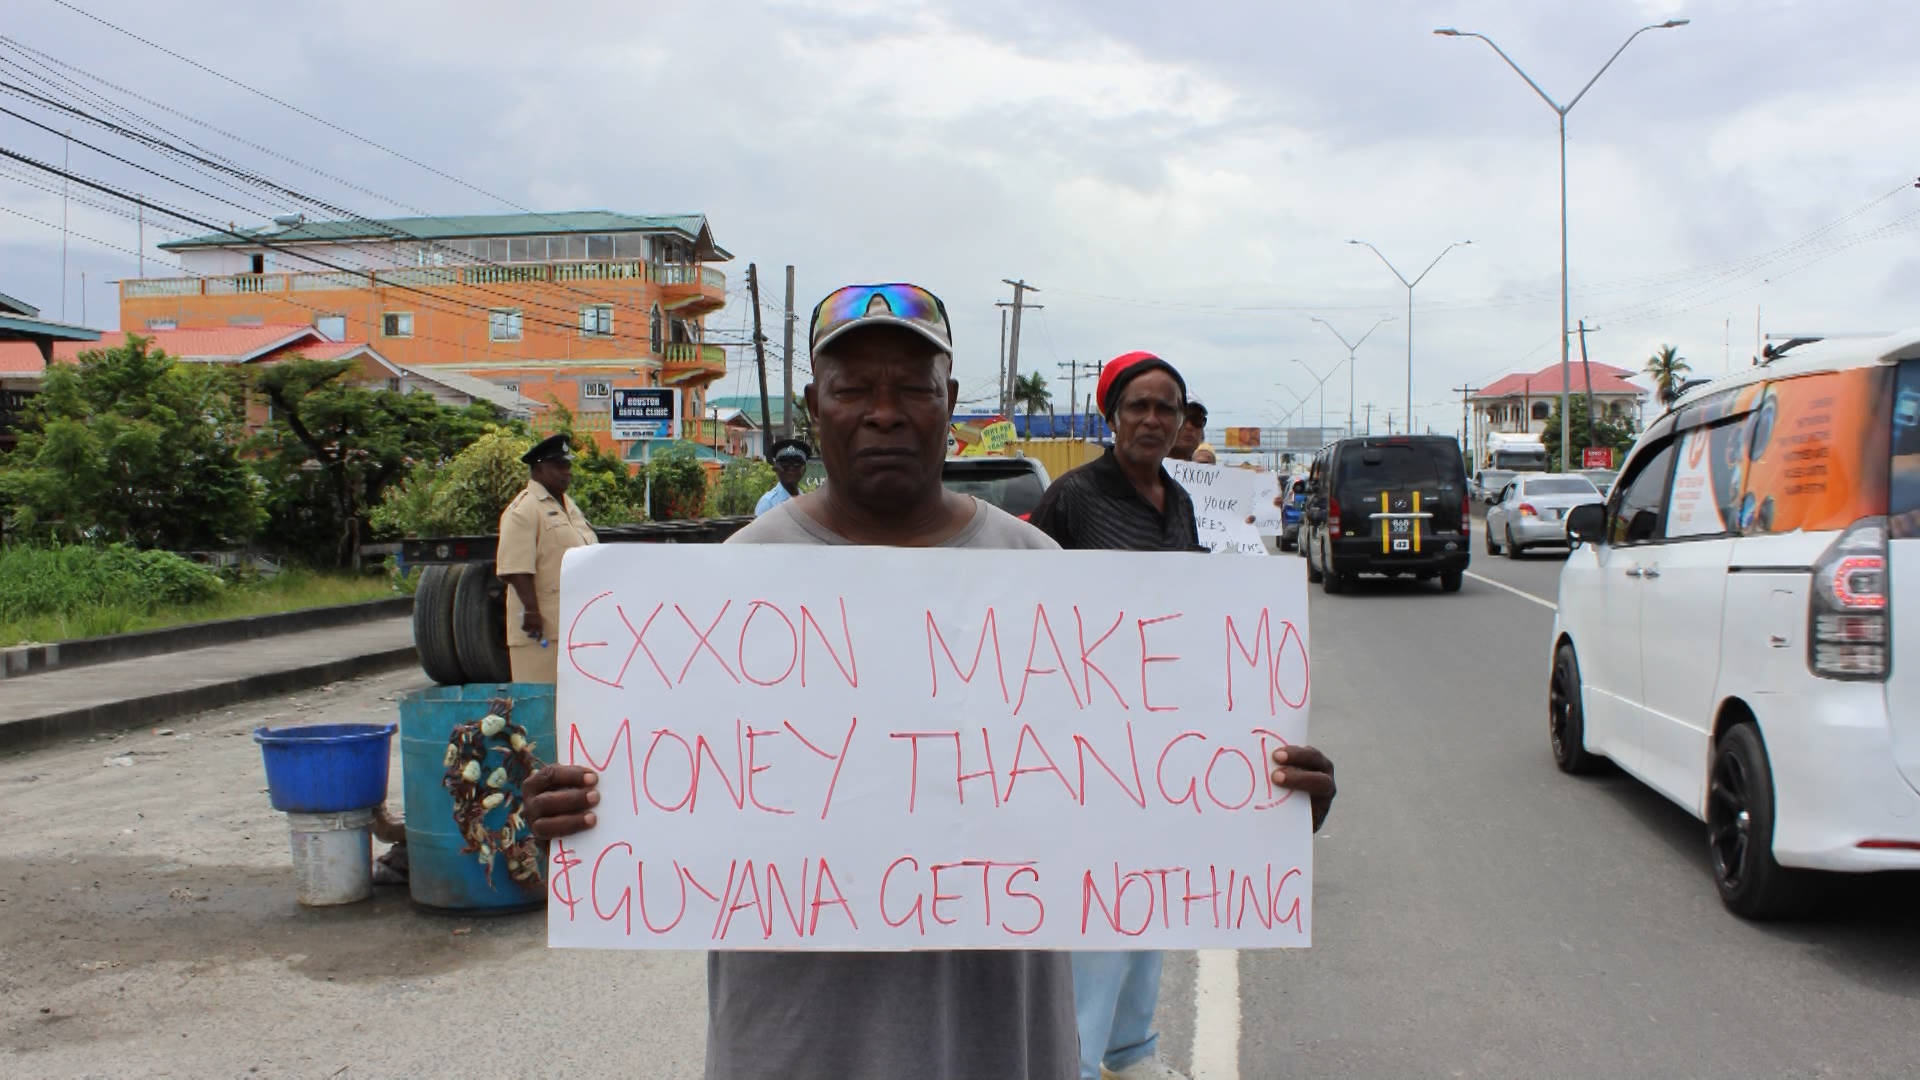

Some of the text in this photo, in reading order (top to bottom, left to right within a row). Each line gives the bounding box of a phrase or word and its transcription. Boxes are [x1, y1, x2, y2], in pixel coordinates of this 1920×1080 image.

[619, 407, 669, 416] DENTAL CLINIC
[568, 592, 1310, 716] EXXON MAKE MO
[570, 718, 857, 820] MONEY
[880, 856, 1045, 936] GETS
[1081, 861, 1303, 936] NOTHING
